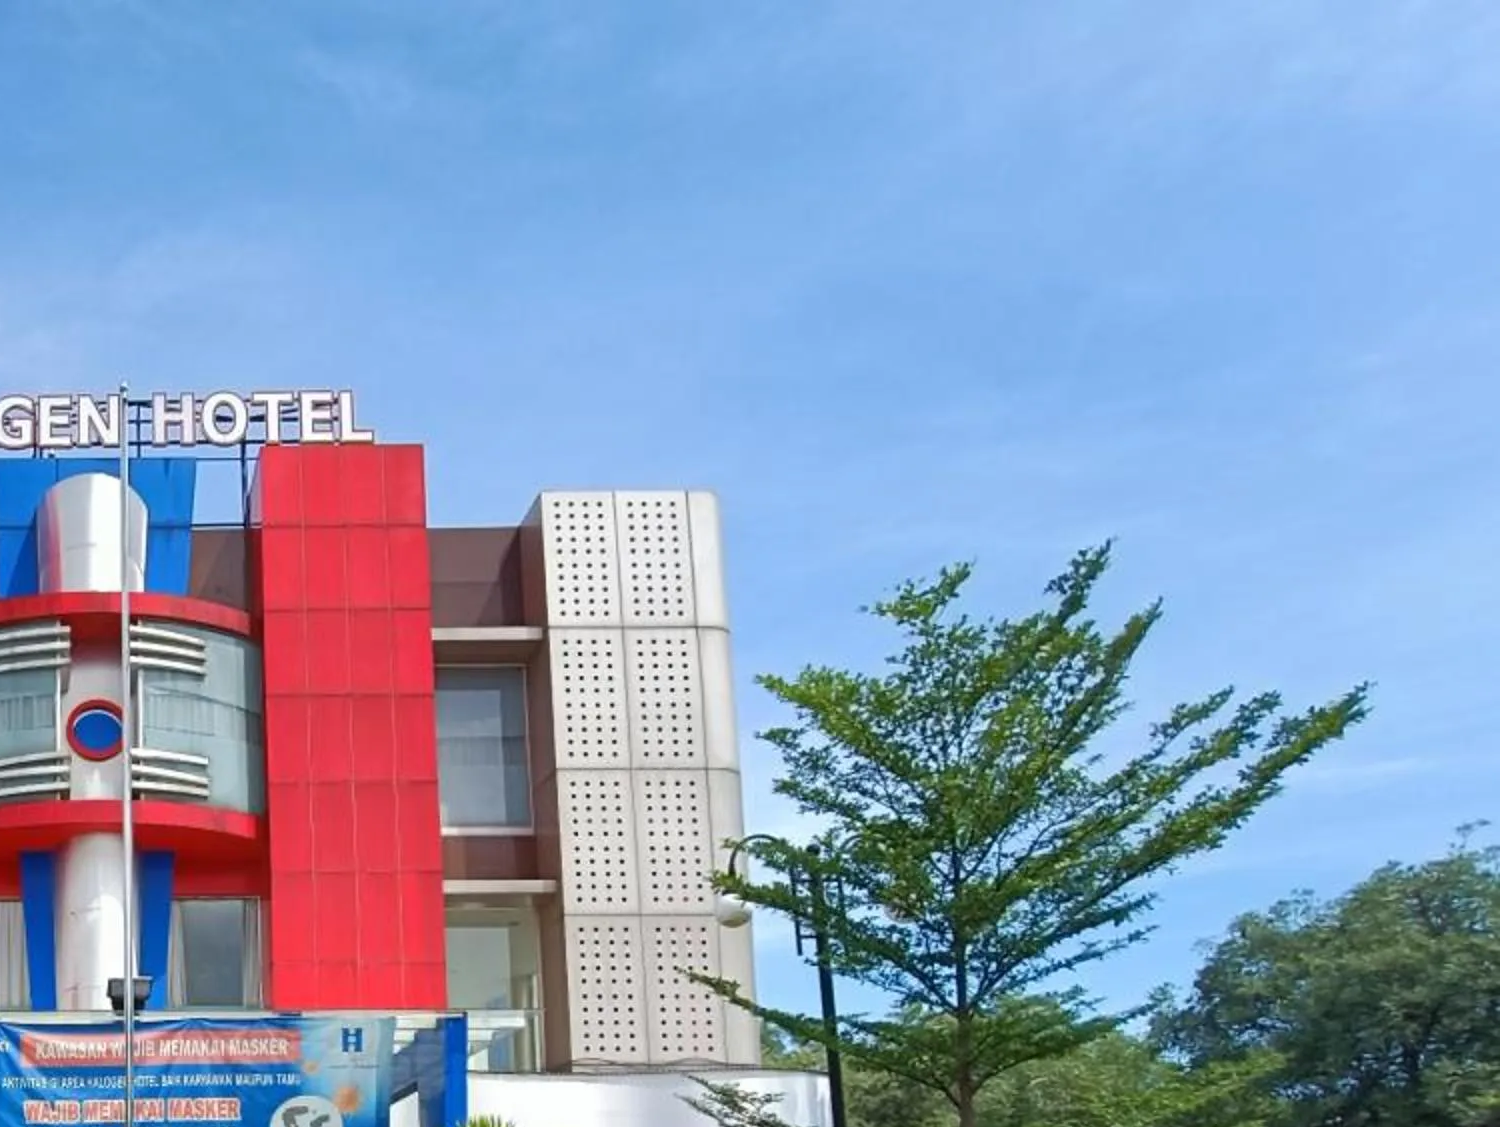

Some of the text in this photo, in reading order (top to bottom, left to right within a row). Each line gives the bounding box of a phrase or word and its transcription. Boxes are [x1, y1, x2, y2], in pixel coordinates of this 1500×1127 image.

[151, 390, 374, 447] HOTEL
[36, 1037, 289, 1060] KAWASAN WJIB MEMAKAI MASKER
[183, 1072, 233, 1086] KARYAWAN
[235, 1072, 273, 1085] MAUPUN
[25, 1098, 241, 1123] WAJIB MEMKAI MASKER
